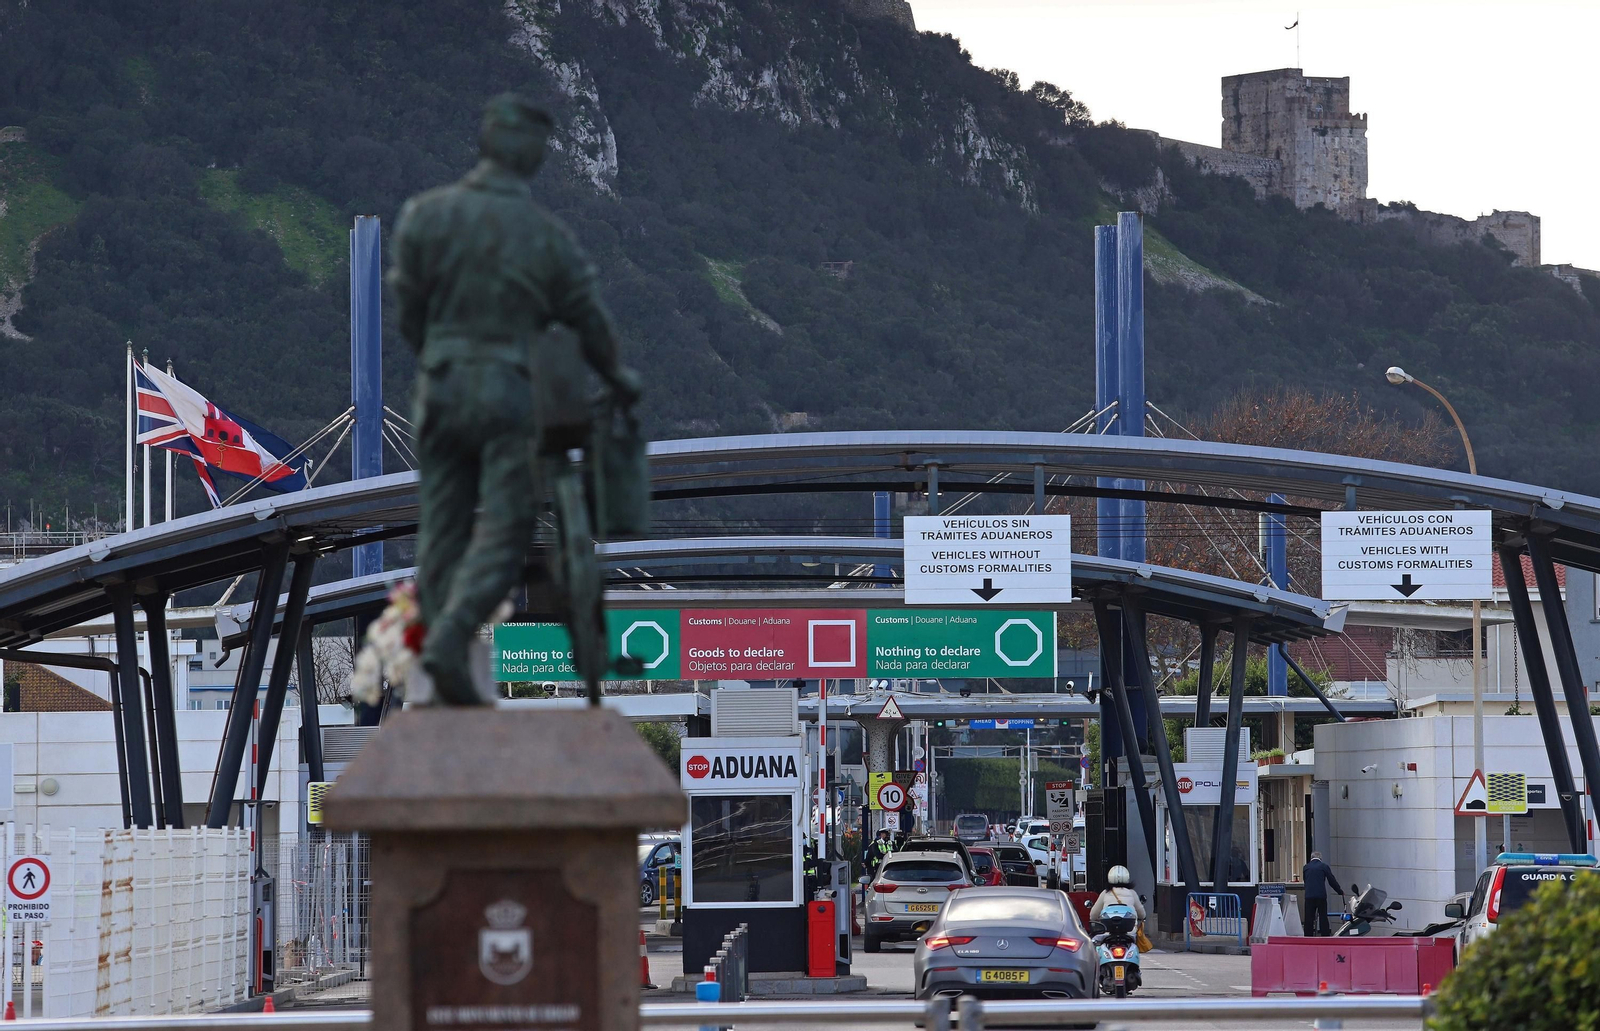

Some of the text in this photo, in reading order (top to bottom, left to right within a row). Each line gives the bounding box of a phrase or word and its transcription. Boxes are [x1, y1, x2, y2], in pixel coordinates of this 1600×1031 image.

[943, 517, 1030, 529] VEHÍCULOS SIN
[1358, 513, 1453, 524] VEHÍCULOS CON
[920, 530, 1053, 540] TRÁMITES ADUANEROS
[1338, 525, 1473, 536] TRÁMITES ADUANEROS
[931, 550, 1040, 560] VEHICLES WITHOUT
[1361, 545, 1448, 555] VEHICLES WITH
[920, 563, 1052, 573] CUSTOMS FORMALITIES
[1338, 559, 1473, 569] CUSTOMS FORMALITIES
[688, 617, 791, 625] Customs Douane Aduana
[875, 616, 977, 624] Customs Douane Aduana
[502, 649, 548, 662] Nothing
[551, 650, 564, 660] to
[688, 647, 784, 658] Goods to declare
[875, 645, 981, 659] Nothing to declare
[502, 663, 529, 673] Nada
[532, 664, 554, 675] para
[688, 660, 796, 674] Objetos para declarar
[875, 659, 971, 672] Nada para declarar
[711, 755, 798, 779] ADUANA
[1177, 781, 1192, 790] STOP
[883, 790, 901, 803] 10
